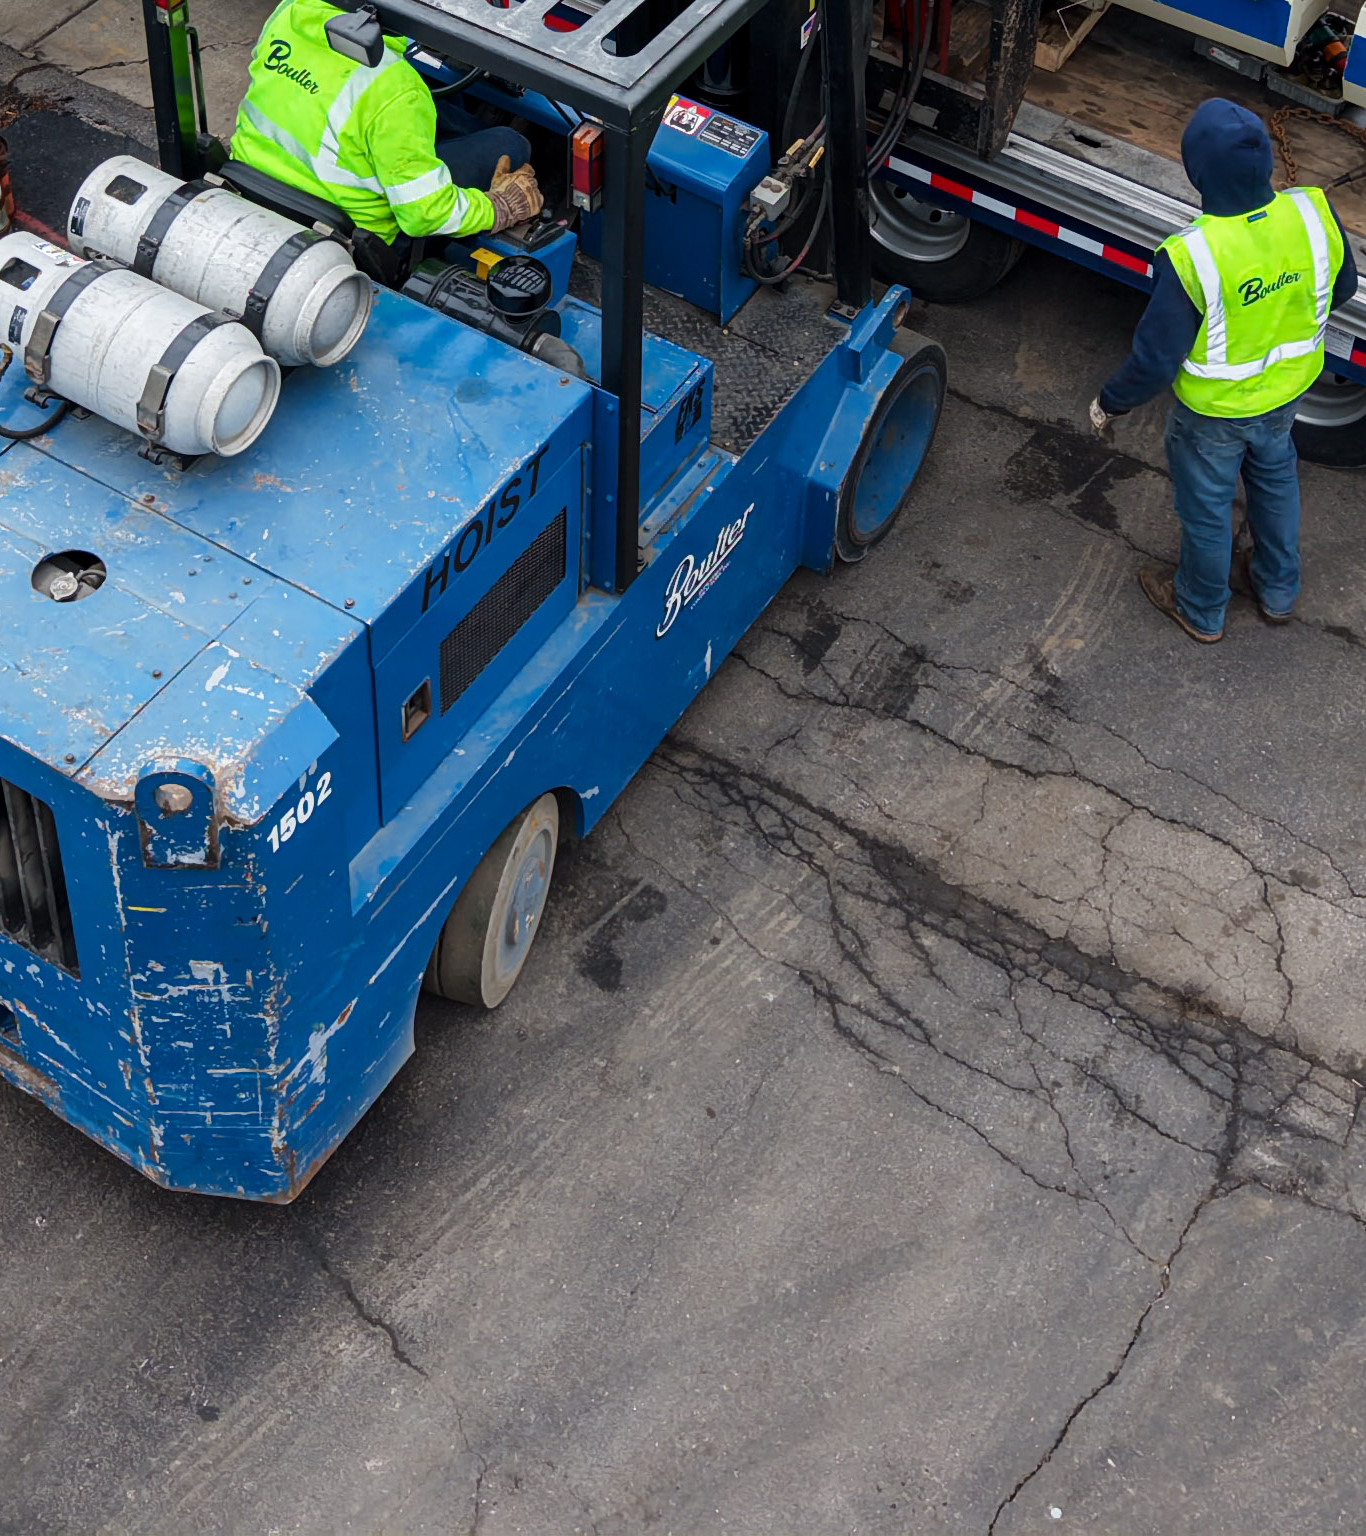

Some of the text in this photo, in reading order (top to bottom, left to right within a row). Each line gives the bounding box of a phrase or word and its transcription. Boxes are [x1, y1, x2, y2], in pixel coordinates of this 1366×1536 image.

[264, 39, 320, 94] Boulter
[1238, 271, 1301, 307] Boulter
[421, 444, 550, 614] HOIST
[656, 502, 755, 638] Boulter
[266, 771, 332, 854] 1502
